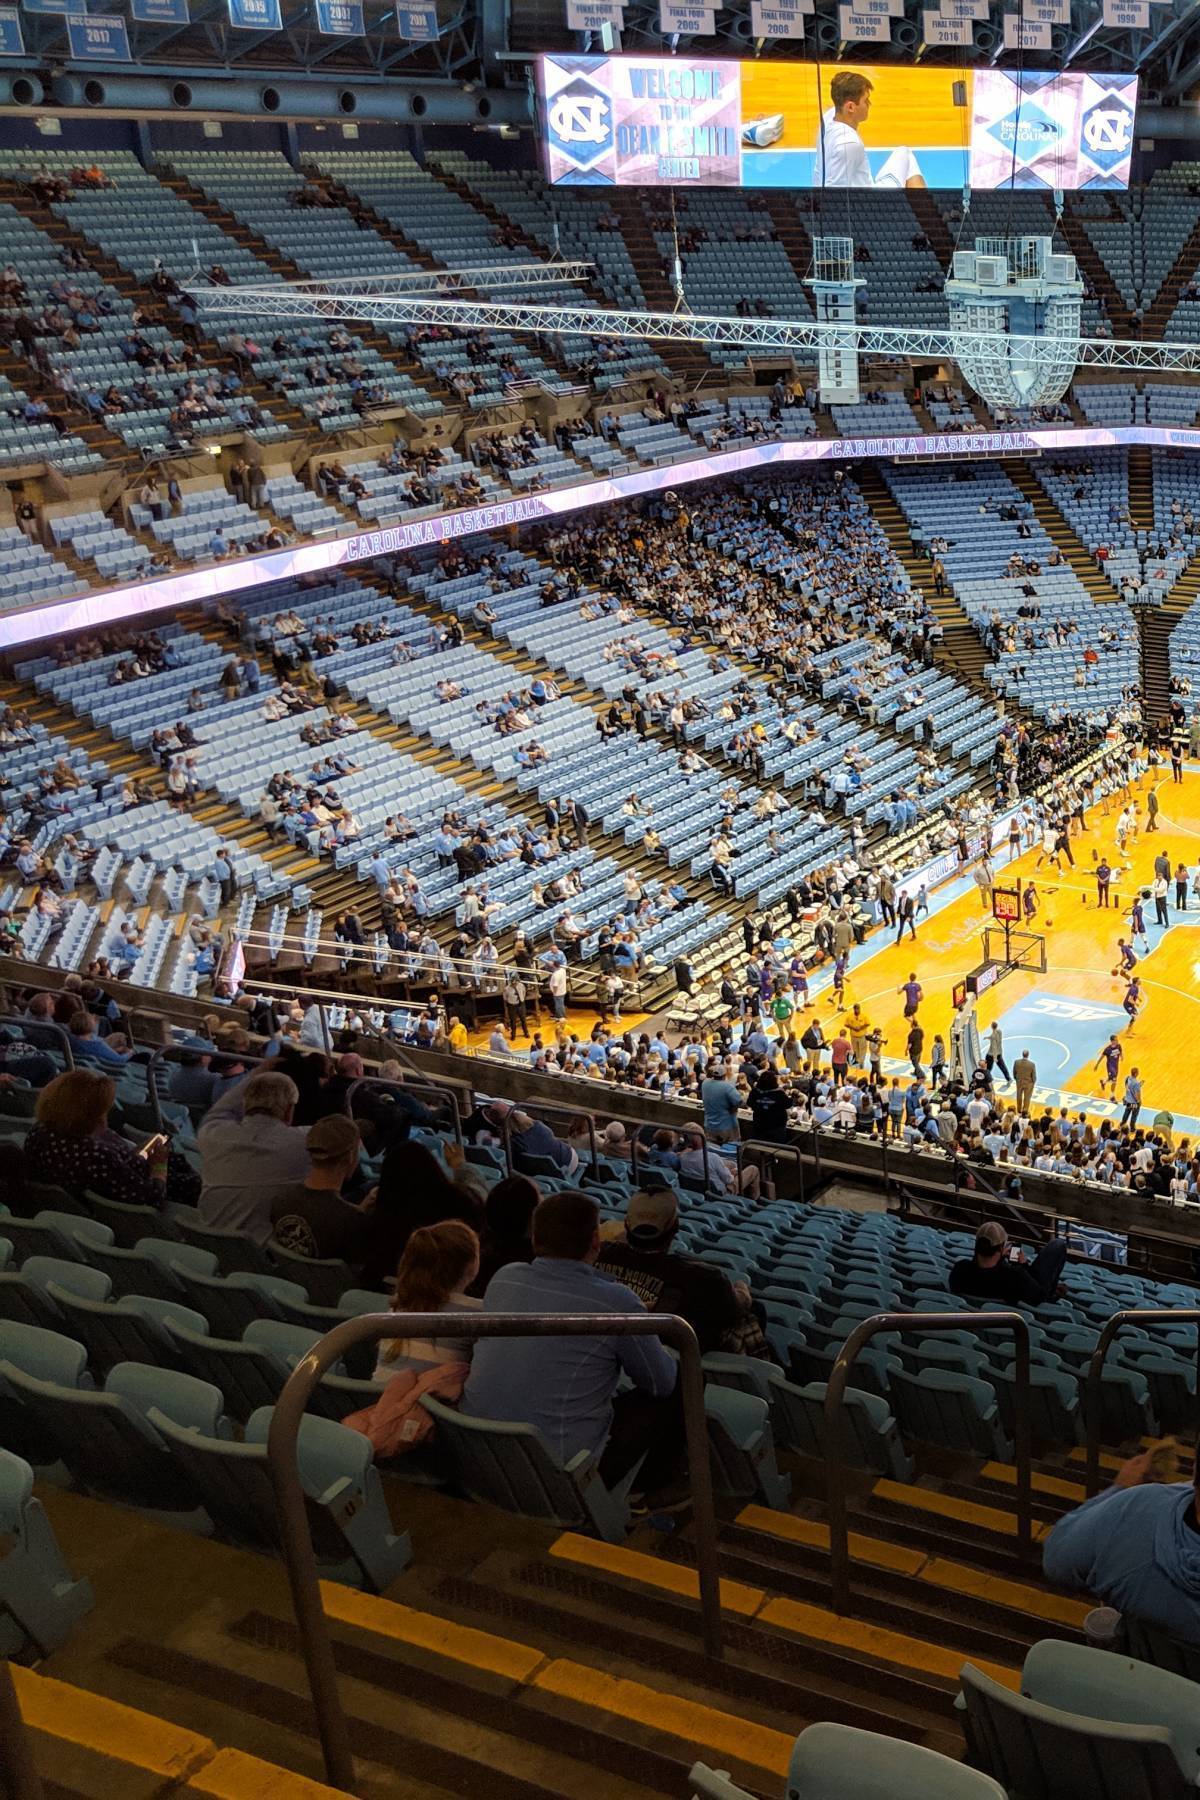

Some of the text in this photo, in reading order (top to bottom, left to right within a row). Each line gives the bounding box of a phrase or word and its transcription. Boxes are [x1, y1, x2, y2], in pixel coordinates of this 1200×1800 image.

[669, 8, 705, 18] FINAL FOUR
[1111, 3, 1126, 11] FINAL
[761, 11, 778, 20] FINAL
[849, 16, 864, 25] FINAL
[677, 20, 699, 30] 2005
[932, 20, 947, 28] FINAL
[86, 29, 110, 43] 2017
[938, 31, 959, 42] 2016
[628, 67, 722, 101] WELCOME
[659, 104, 673, 121] TO
[615, 123, 660, 156] DEAN
[683, 126, 737, 157] SMITH
[658, 158, 700, 178] CENTER
[831, 433, 1034, 458] CAROLINA BASKETBALL
[347, 498, 545, 561] CAROLINA BASKETBALL
[1020, 998, 1133, 1022] ACC
